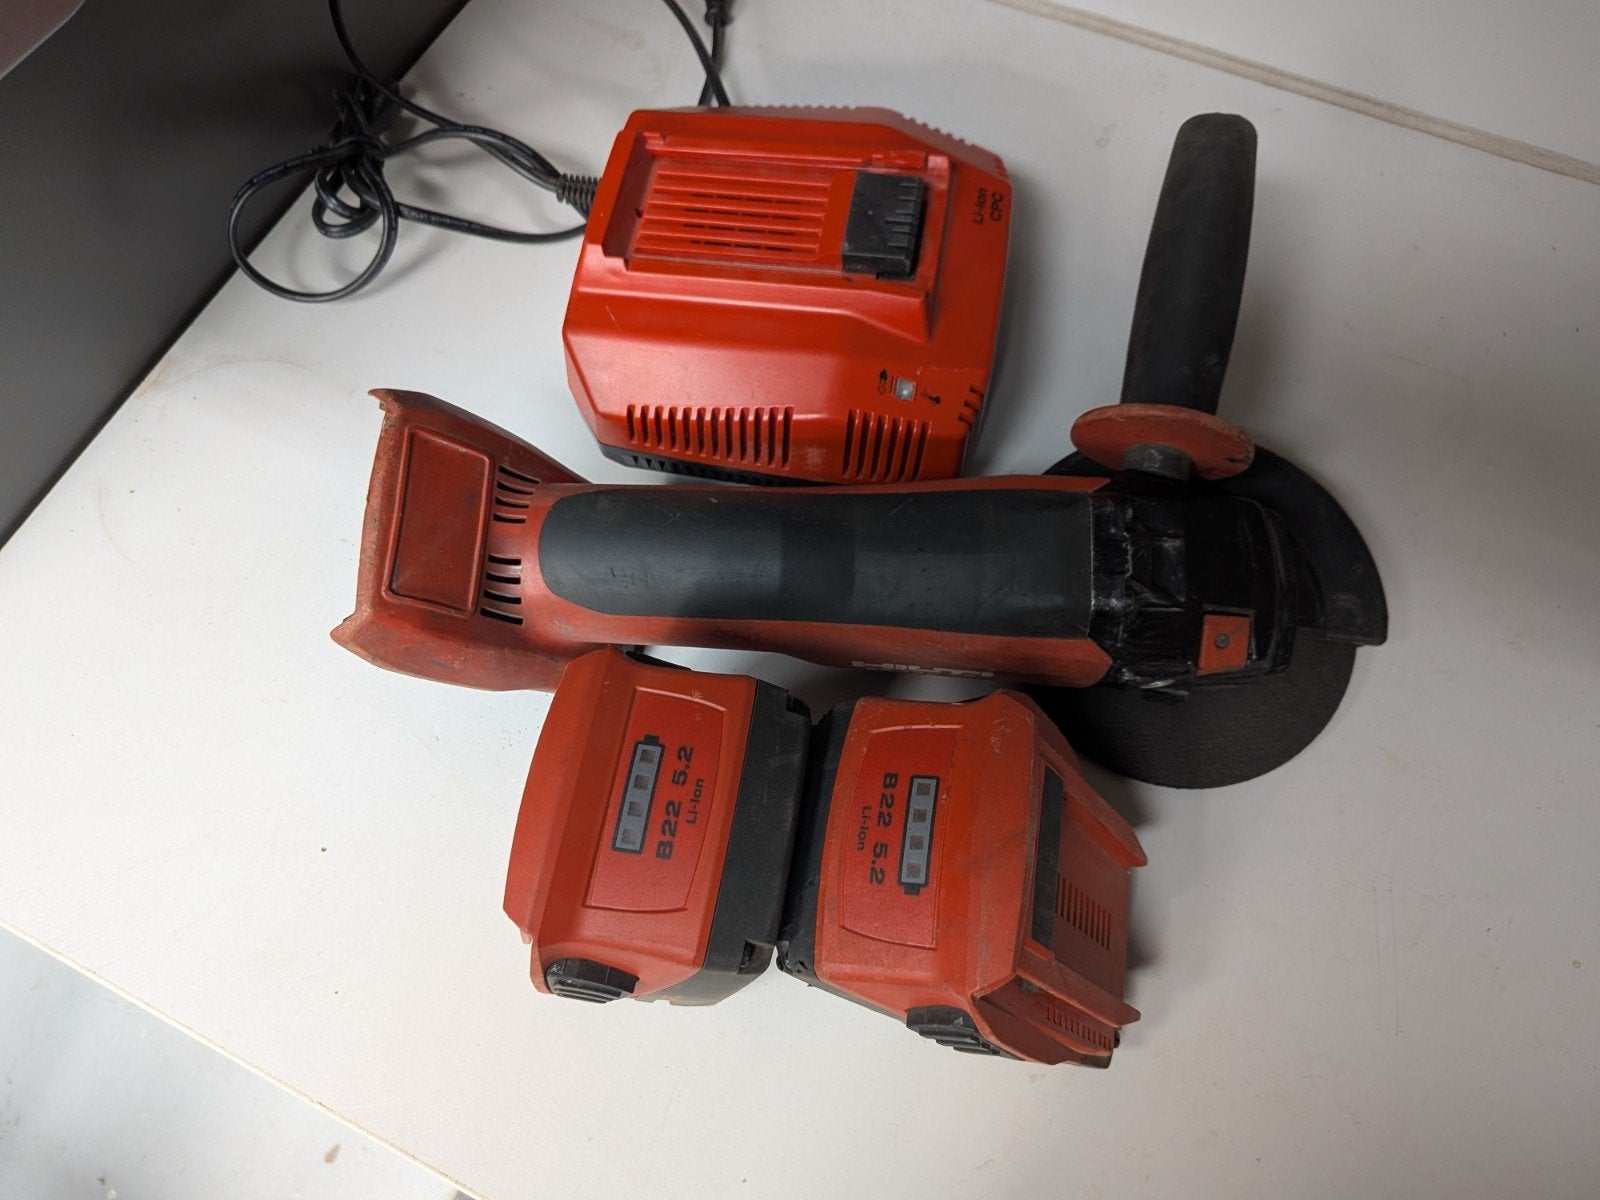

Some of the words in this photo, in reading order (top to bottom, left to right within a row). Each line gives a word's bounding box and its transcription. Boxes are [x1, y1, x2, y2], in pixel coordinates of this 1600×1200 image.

[990, 191, 1004, 222] CPC
[655, 800, 682, 859] B22
[671, 745, 694, 786] 5.2
[877, 773, 899, 827] B22
[869, 842, 888, 885] 5.2
